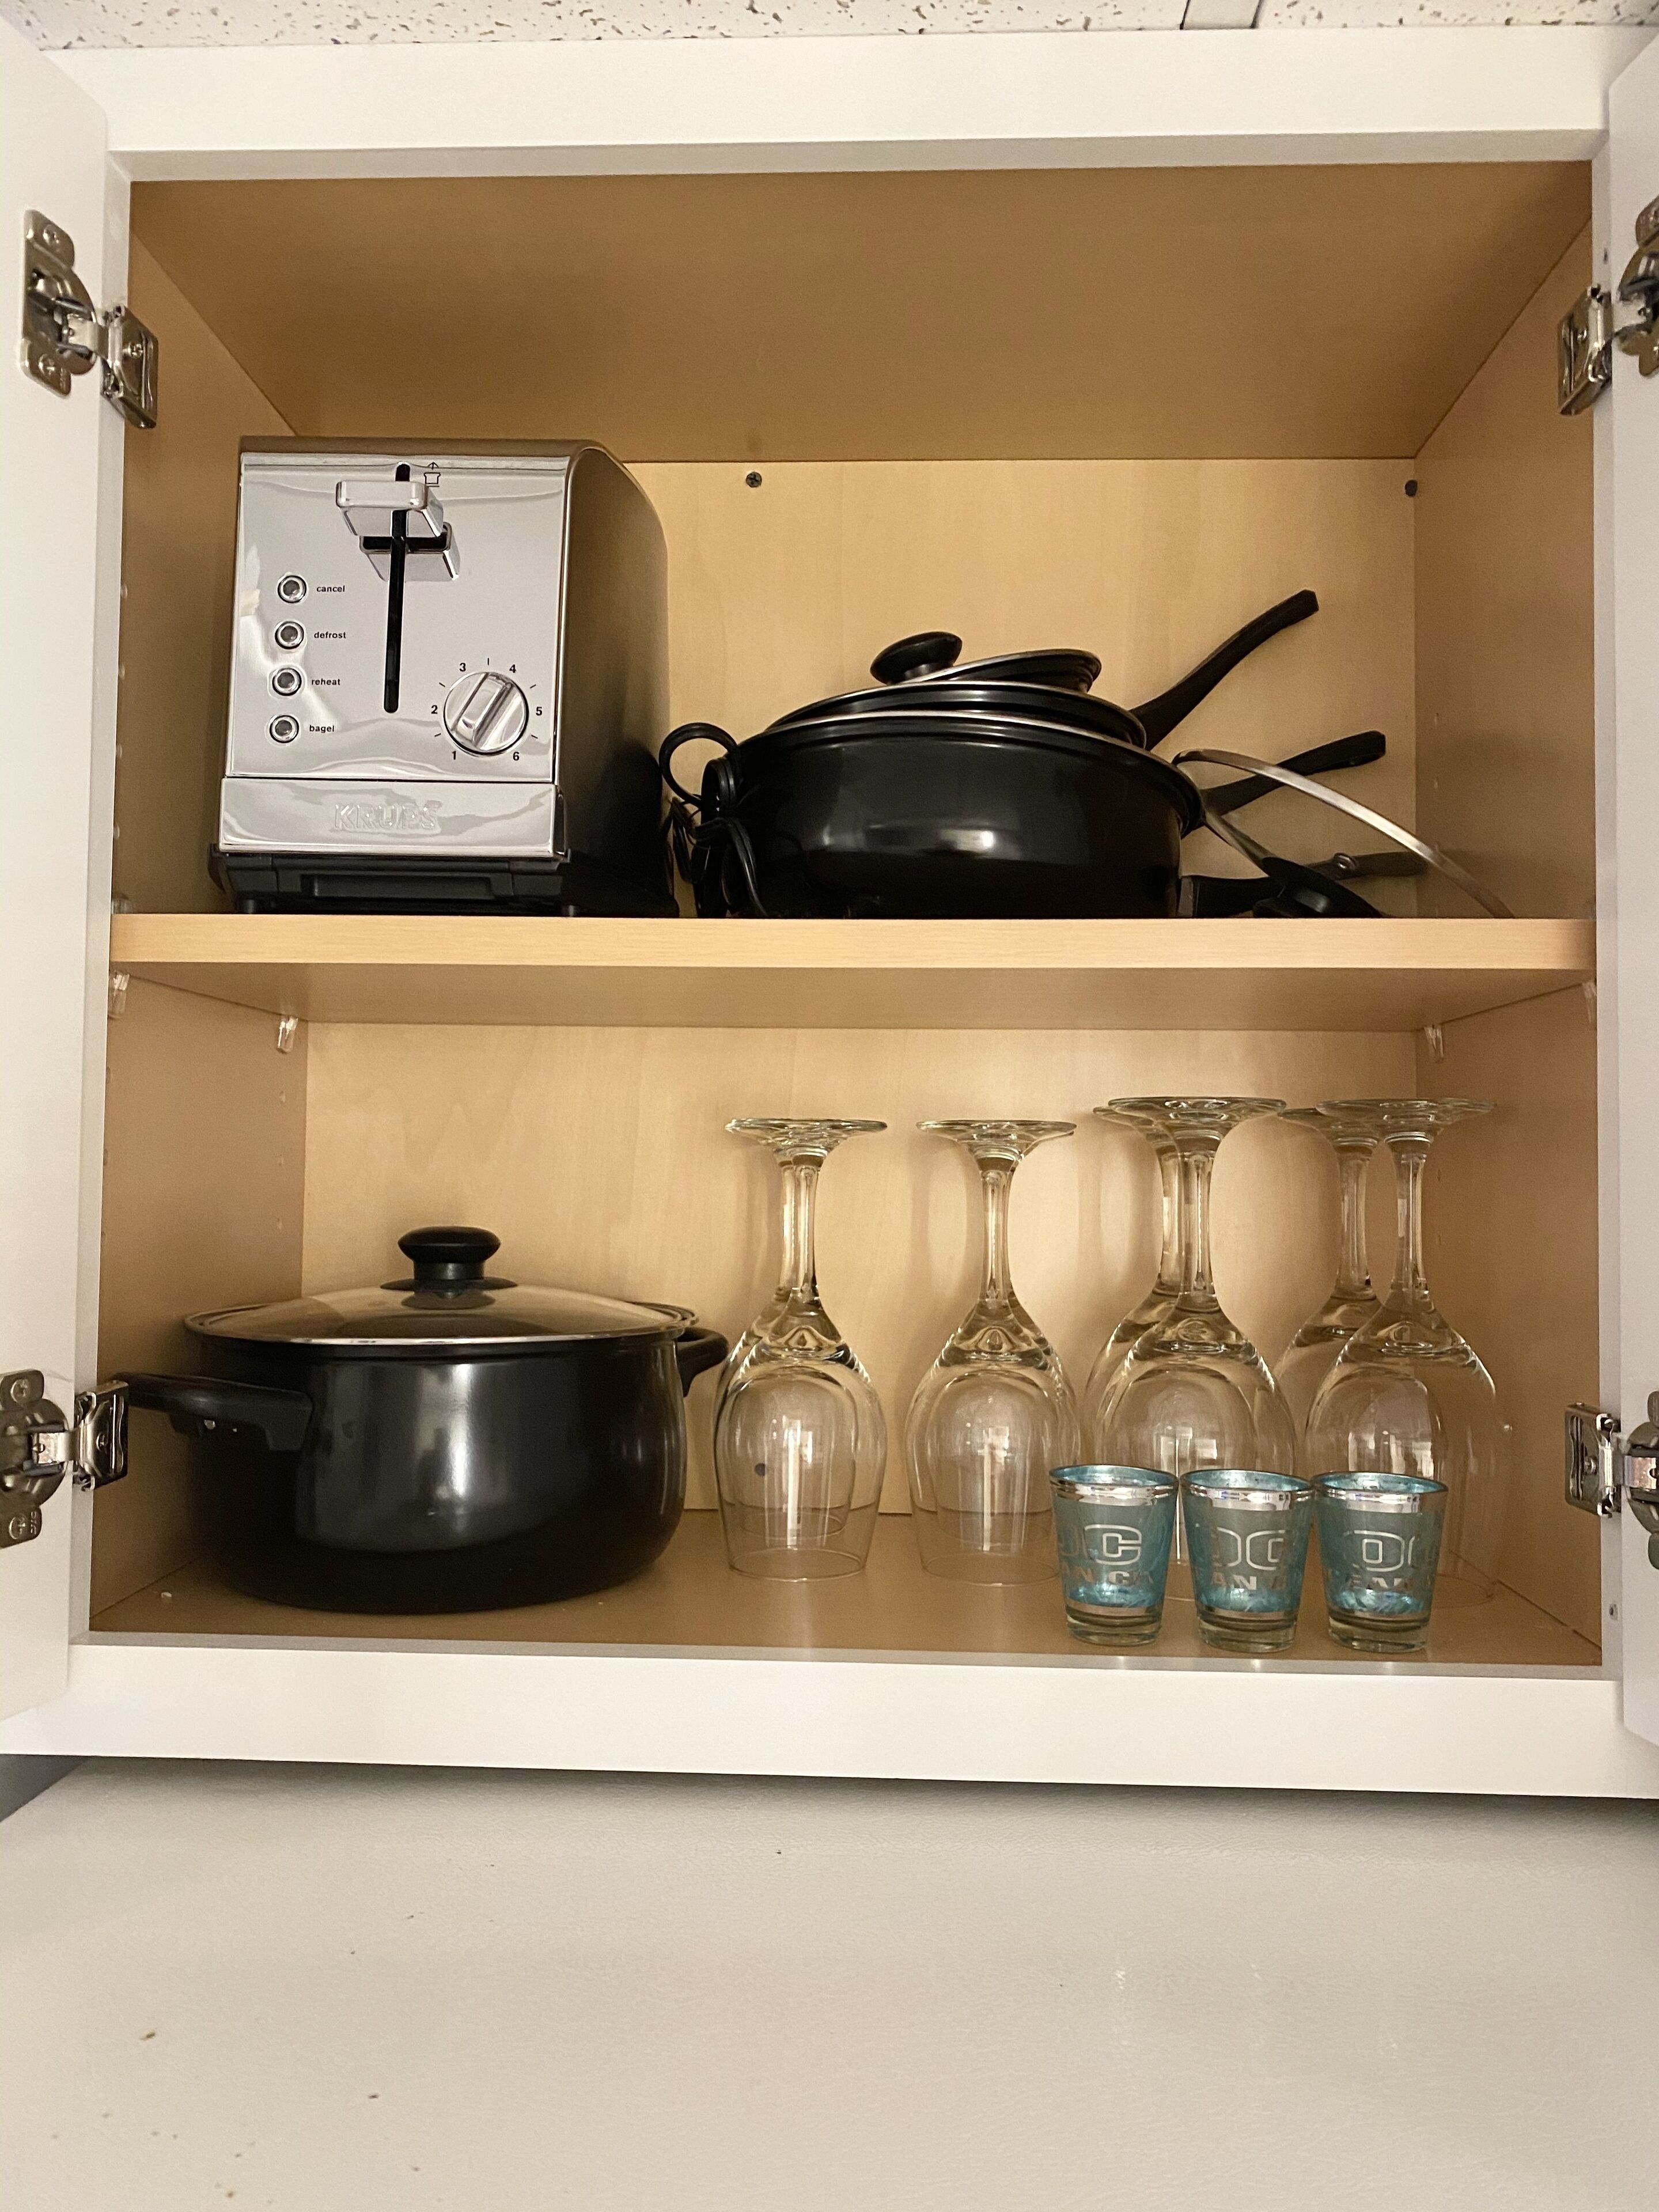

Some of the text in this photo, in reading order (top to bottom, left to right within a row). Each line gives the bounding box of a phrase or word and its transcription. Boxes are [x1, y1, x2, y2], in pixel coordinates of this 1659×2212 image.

[459, 662, 466, 672] 3
[509, 664, 516, 673] 4
[431, 704, 438, 714] 2
[536, 707, 543, 715] 5
[309, 725, 335, 733] bagel
[452, 751, 456, 760] 1
[513, 752, 520, 761] 6
[334, 804, 441, 830] KRUPS
